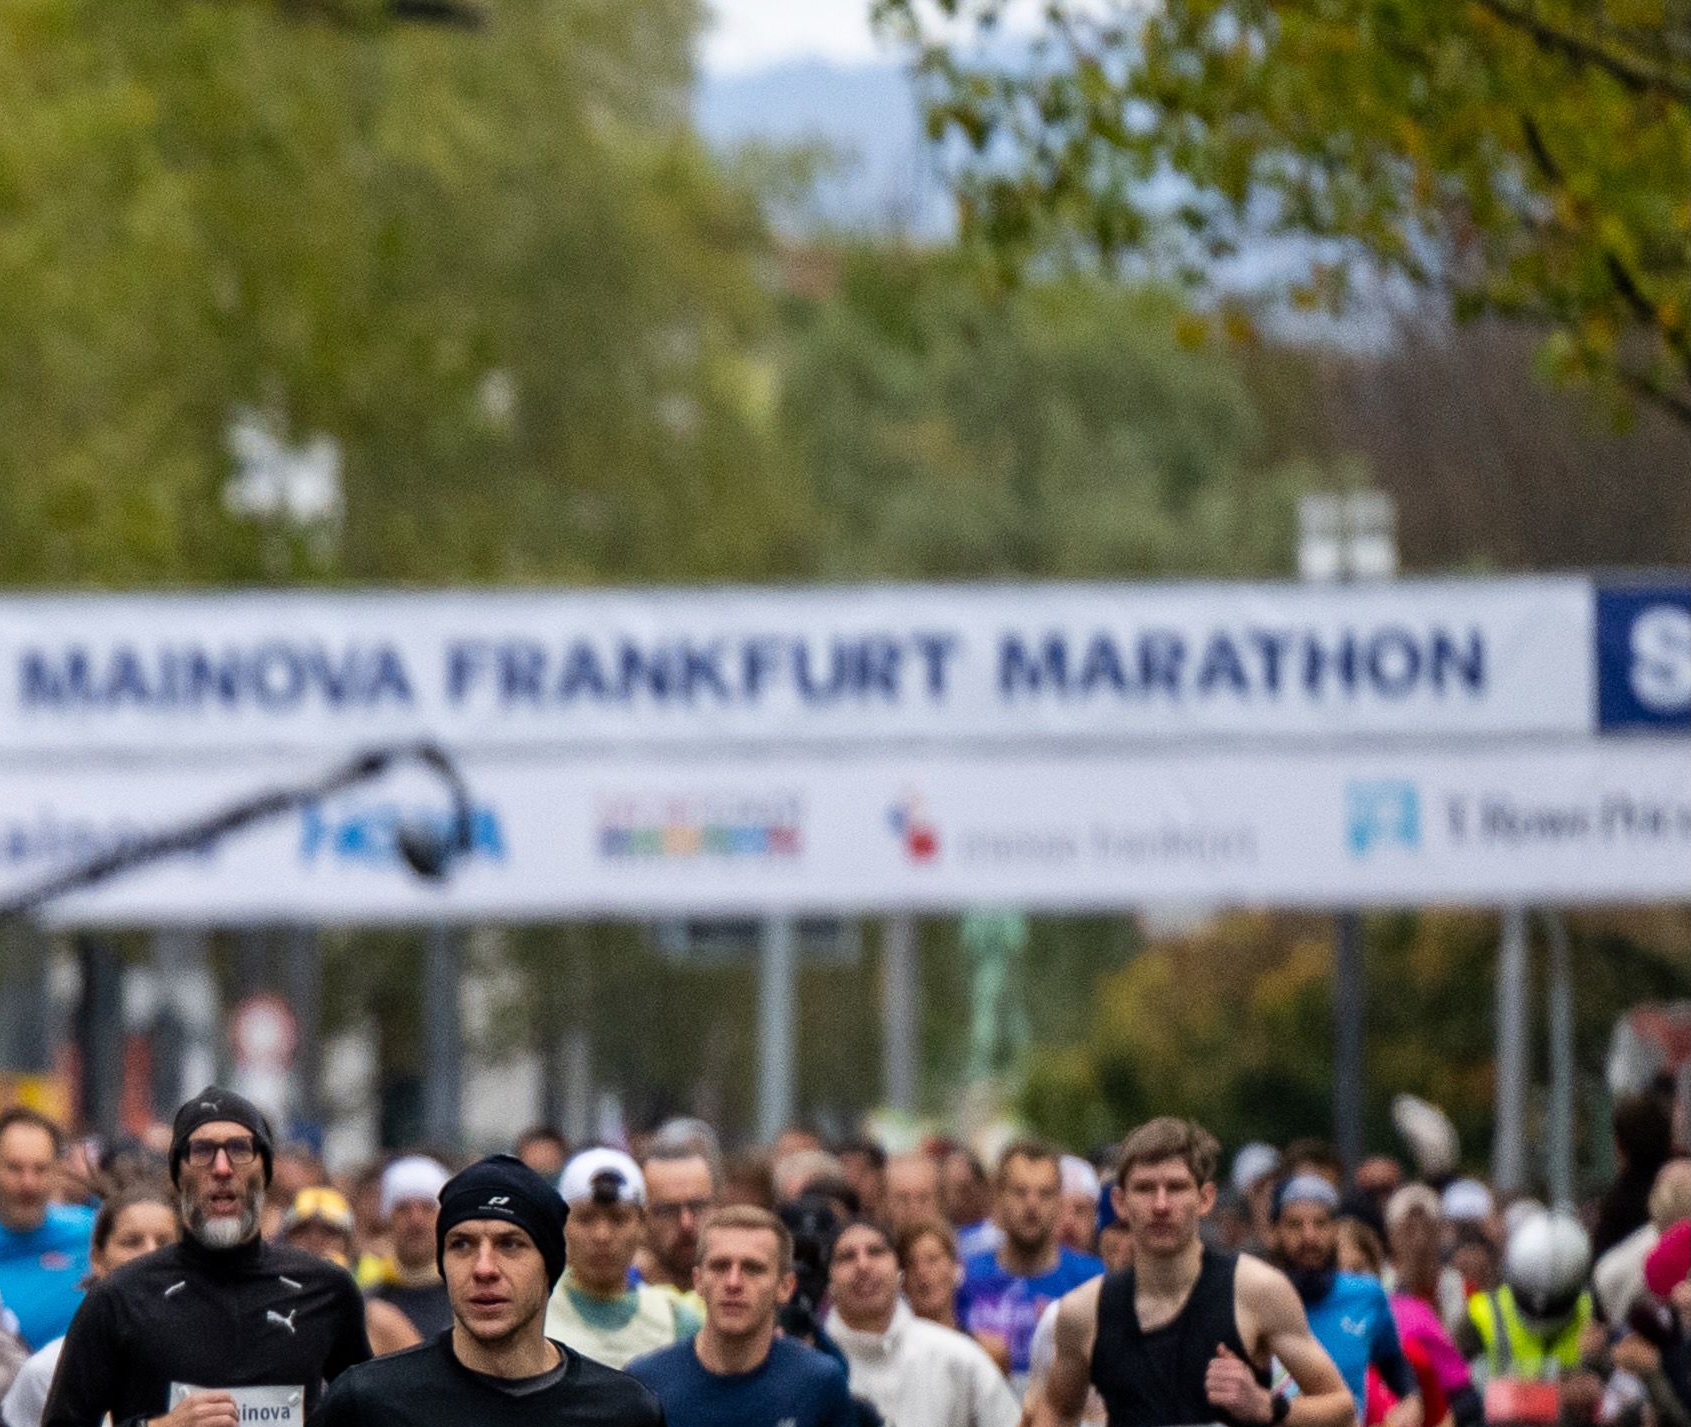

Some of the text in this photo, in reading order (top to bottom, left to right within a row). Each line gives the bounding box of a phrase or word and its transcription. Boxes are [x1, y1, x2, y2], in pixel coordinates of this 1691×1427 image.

[22, 626, 1488, 710] MAINOVA FRANKFURT MARATHON
[242, 1403, 292, 1422] inova
